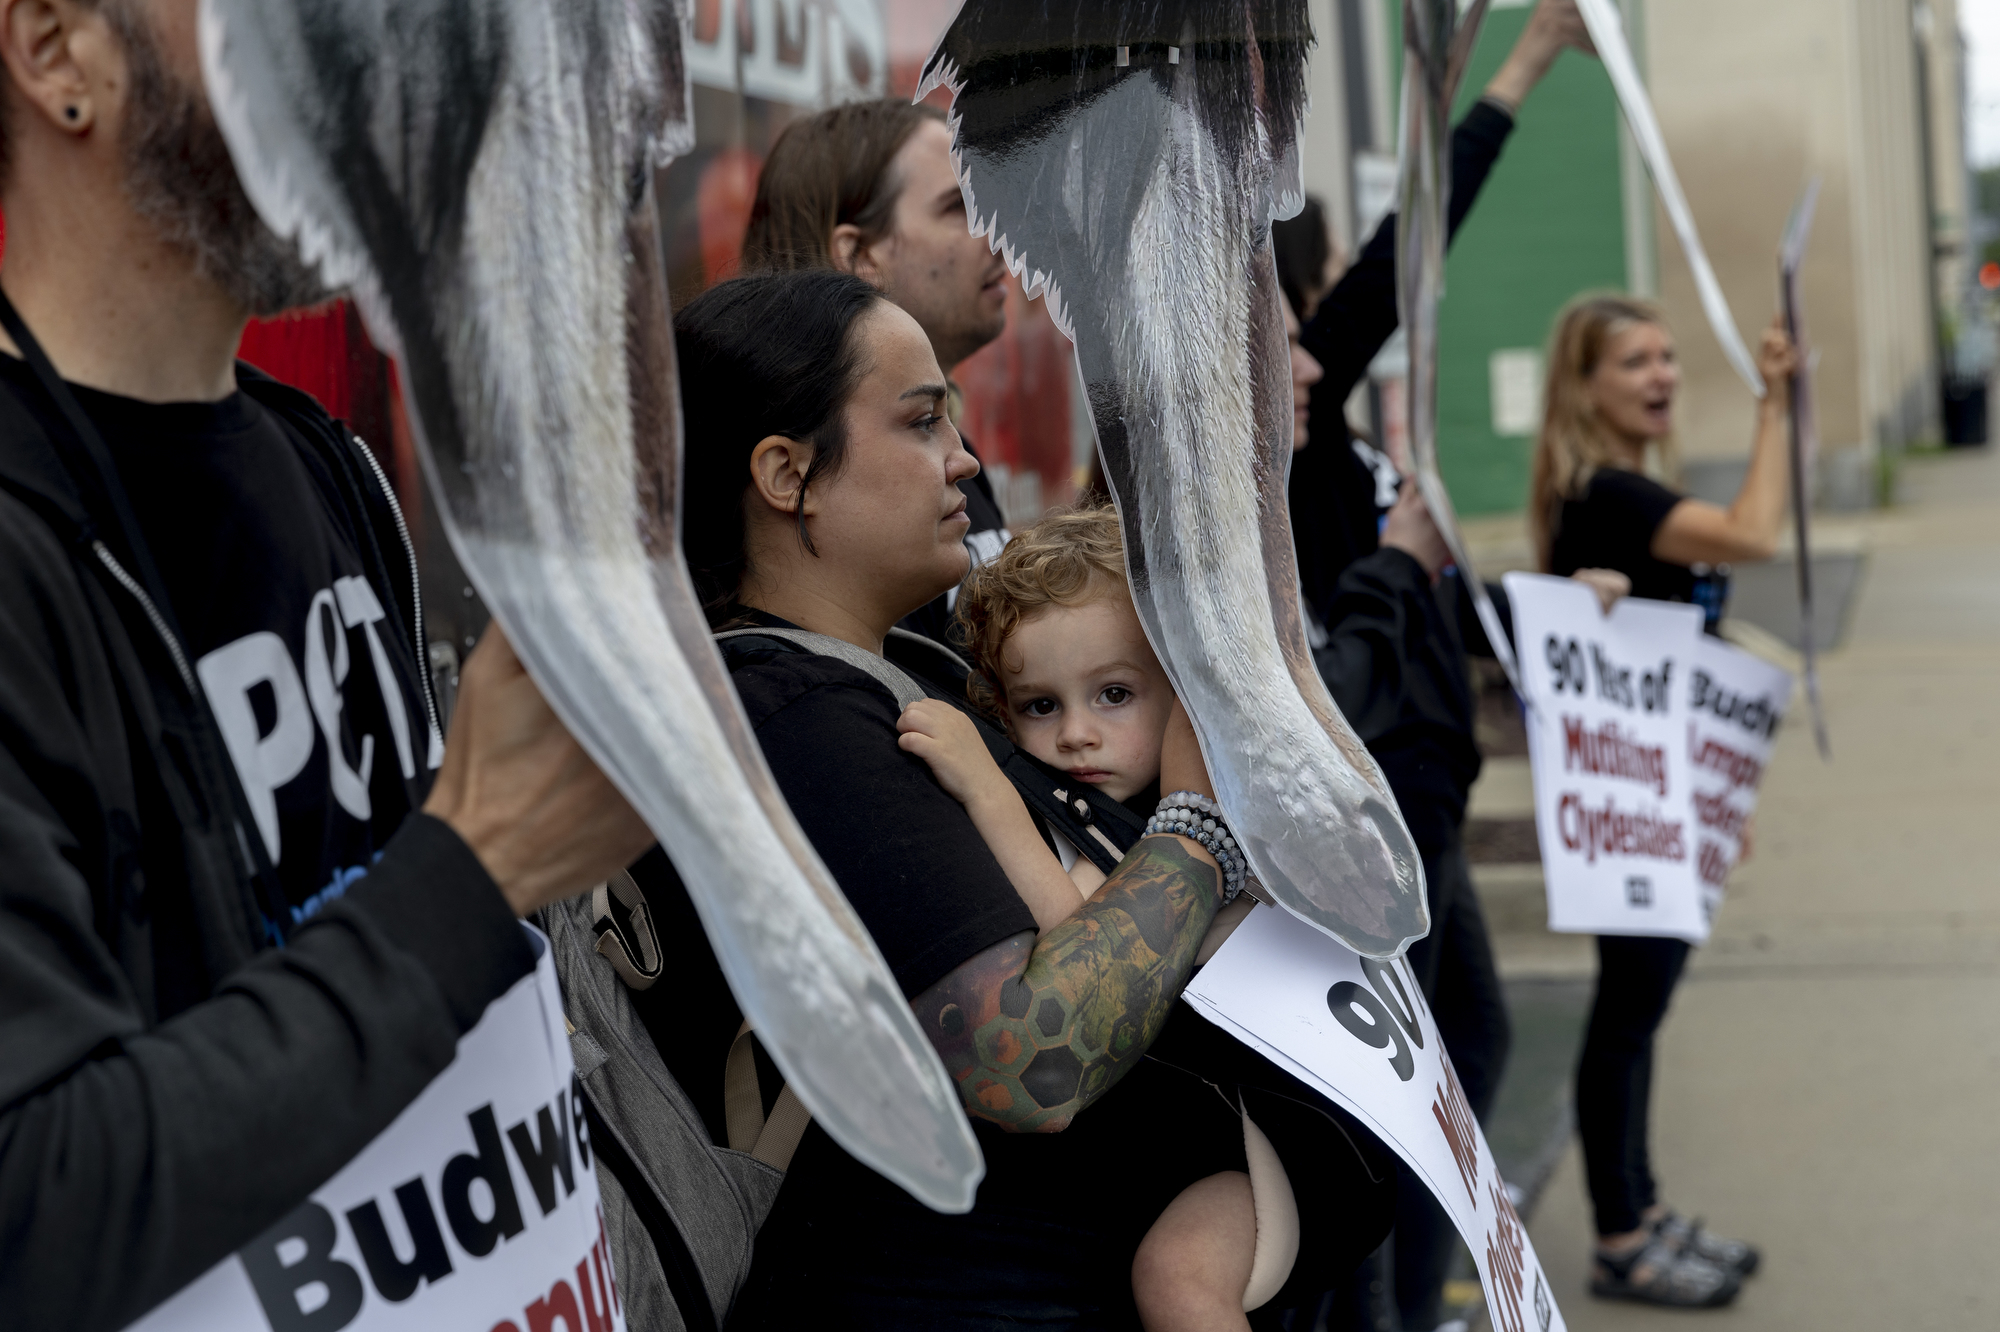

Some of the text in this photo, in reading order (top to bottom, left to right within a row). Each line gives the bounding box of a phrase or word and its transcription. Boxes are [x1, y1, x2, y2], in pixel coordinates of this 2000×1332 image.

[1545, 633, 1588, 695] 90
[1640, 656, 1675, 713] of
[1327, 955, 1424, 1082] 90
